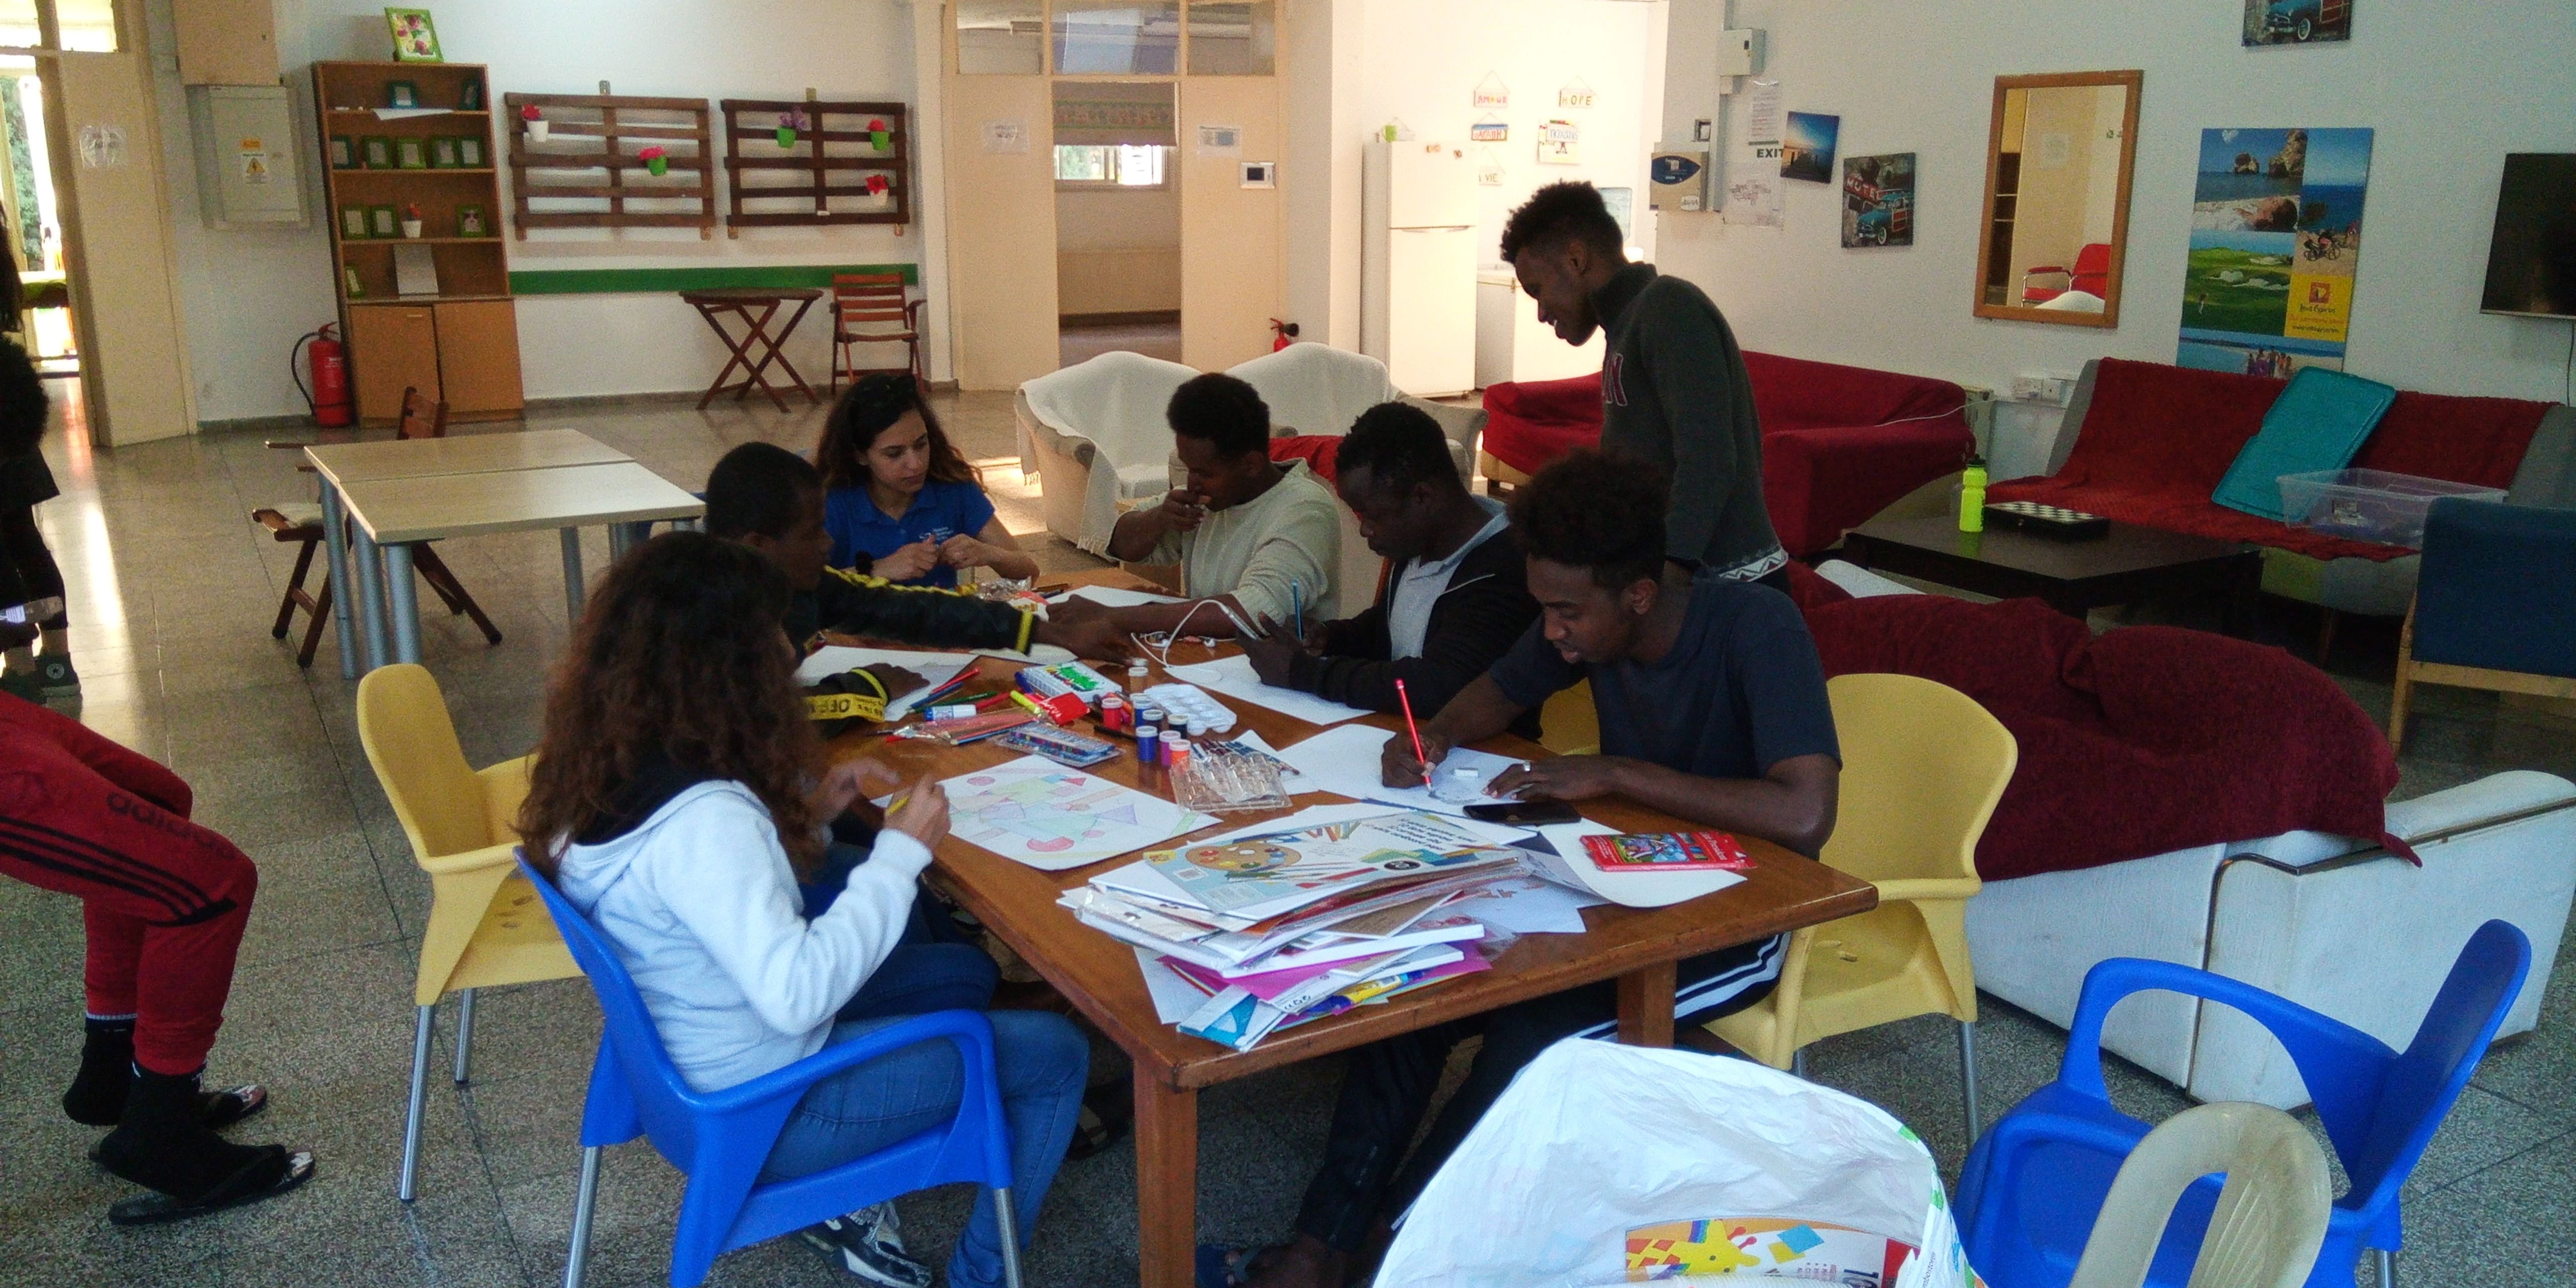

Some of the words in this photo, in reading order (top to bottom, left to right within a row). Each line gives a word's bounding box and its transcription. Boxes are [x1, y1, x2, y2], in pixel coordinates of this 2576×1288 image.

[1562, 96, 1592, 106] HOPE
[1756, 148, 1784, 158] EXIT
[1485, 174, 1498, 182] VIE
